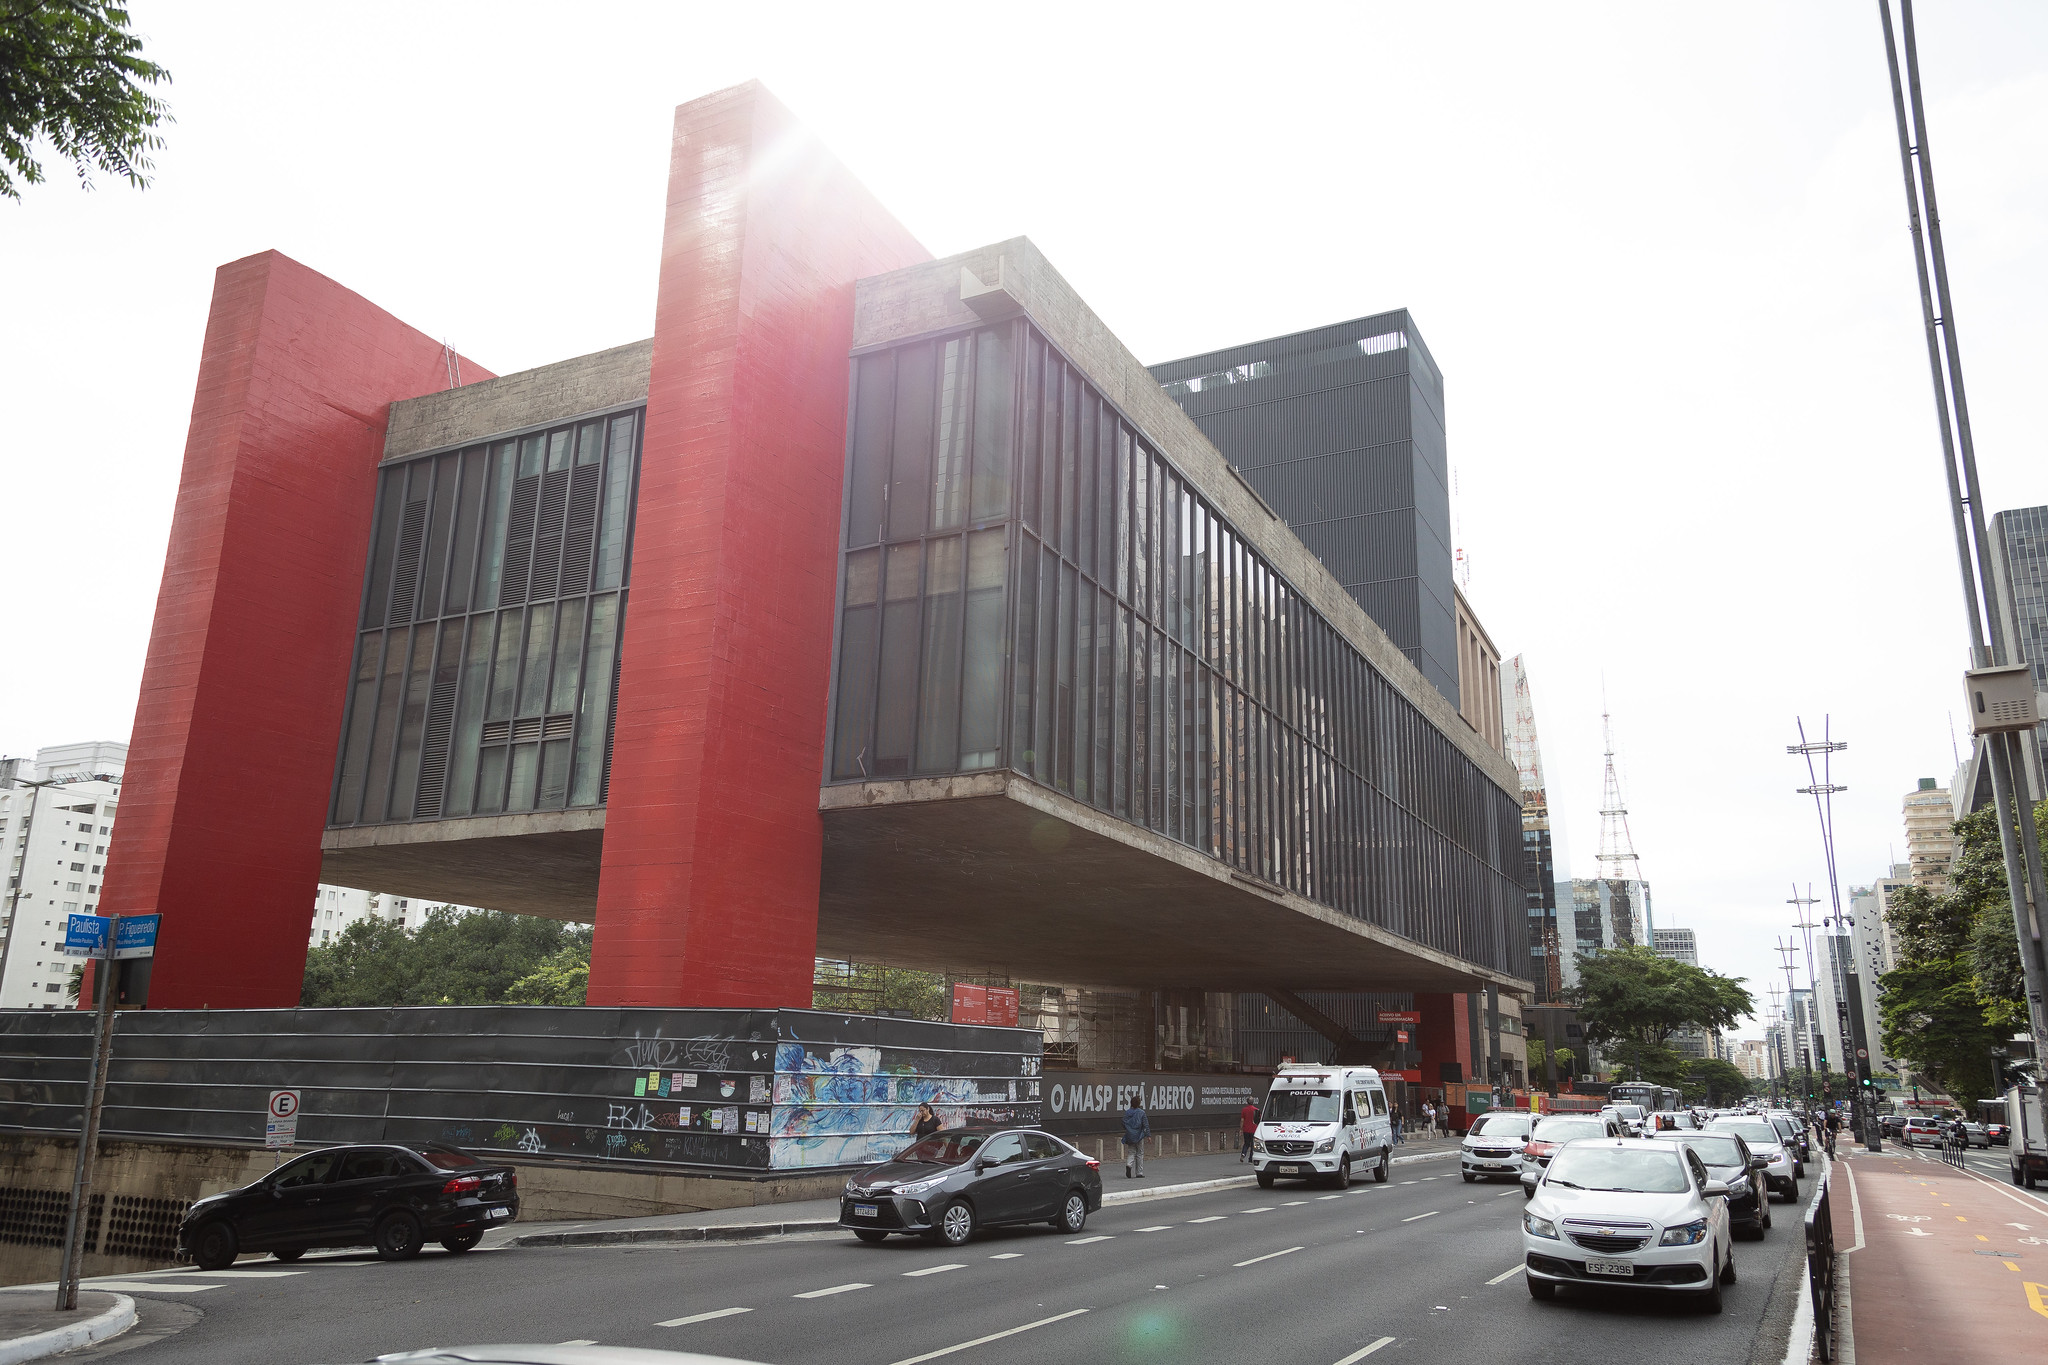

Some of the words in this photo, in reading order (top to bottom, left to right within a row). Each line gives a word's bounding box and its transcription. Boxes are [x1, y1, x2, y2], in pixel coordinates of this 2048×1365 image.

[70, 916, 100, 934] Paulista
[125, 920, 155, 937] Figueiredo
[279, 1098, 290, 1112] E
[1050, 1083, 1065, 1113] O
[1068, 1084, 1113, 1112] MASP
[1149, 1085, 1195, 1110] ABERTO
